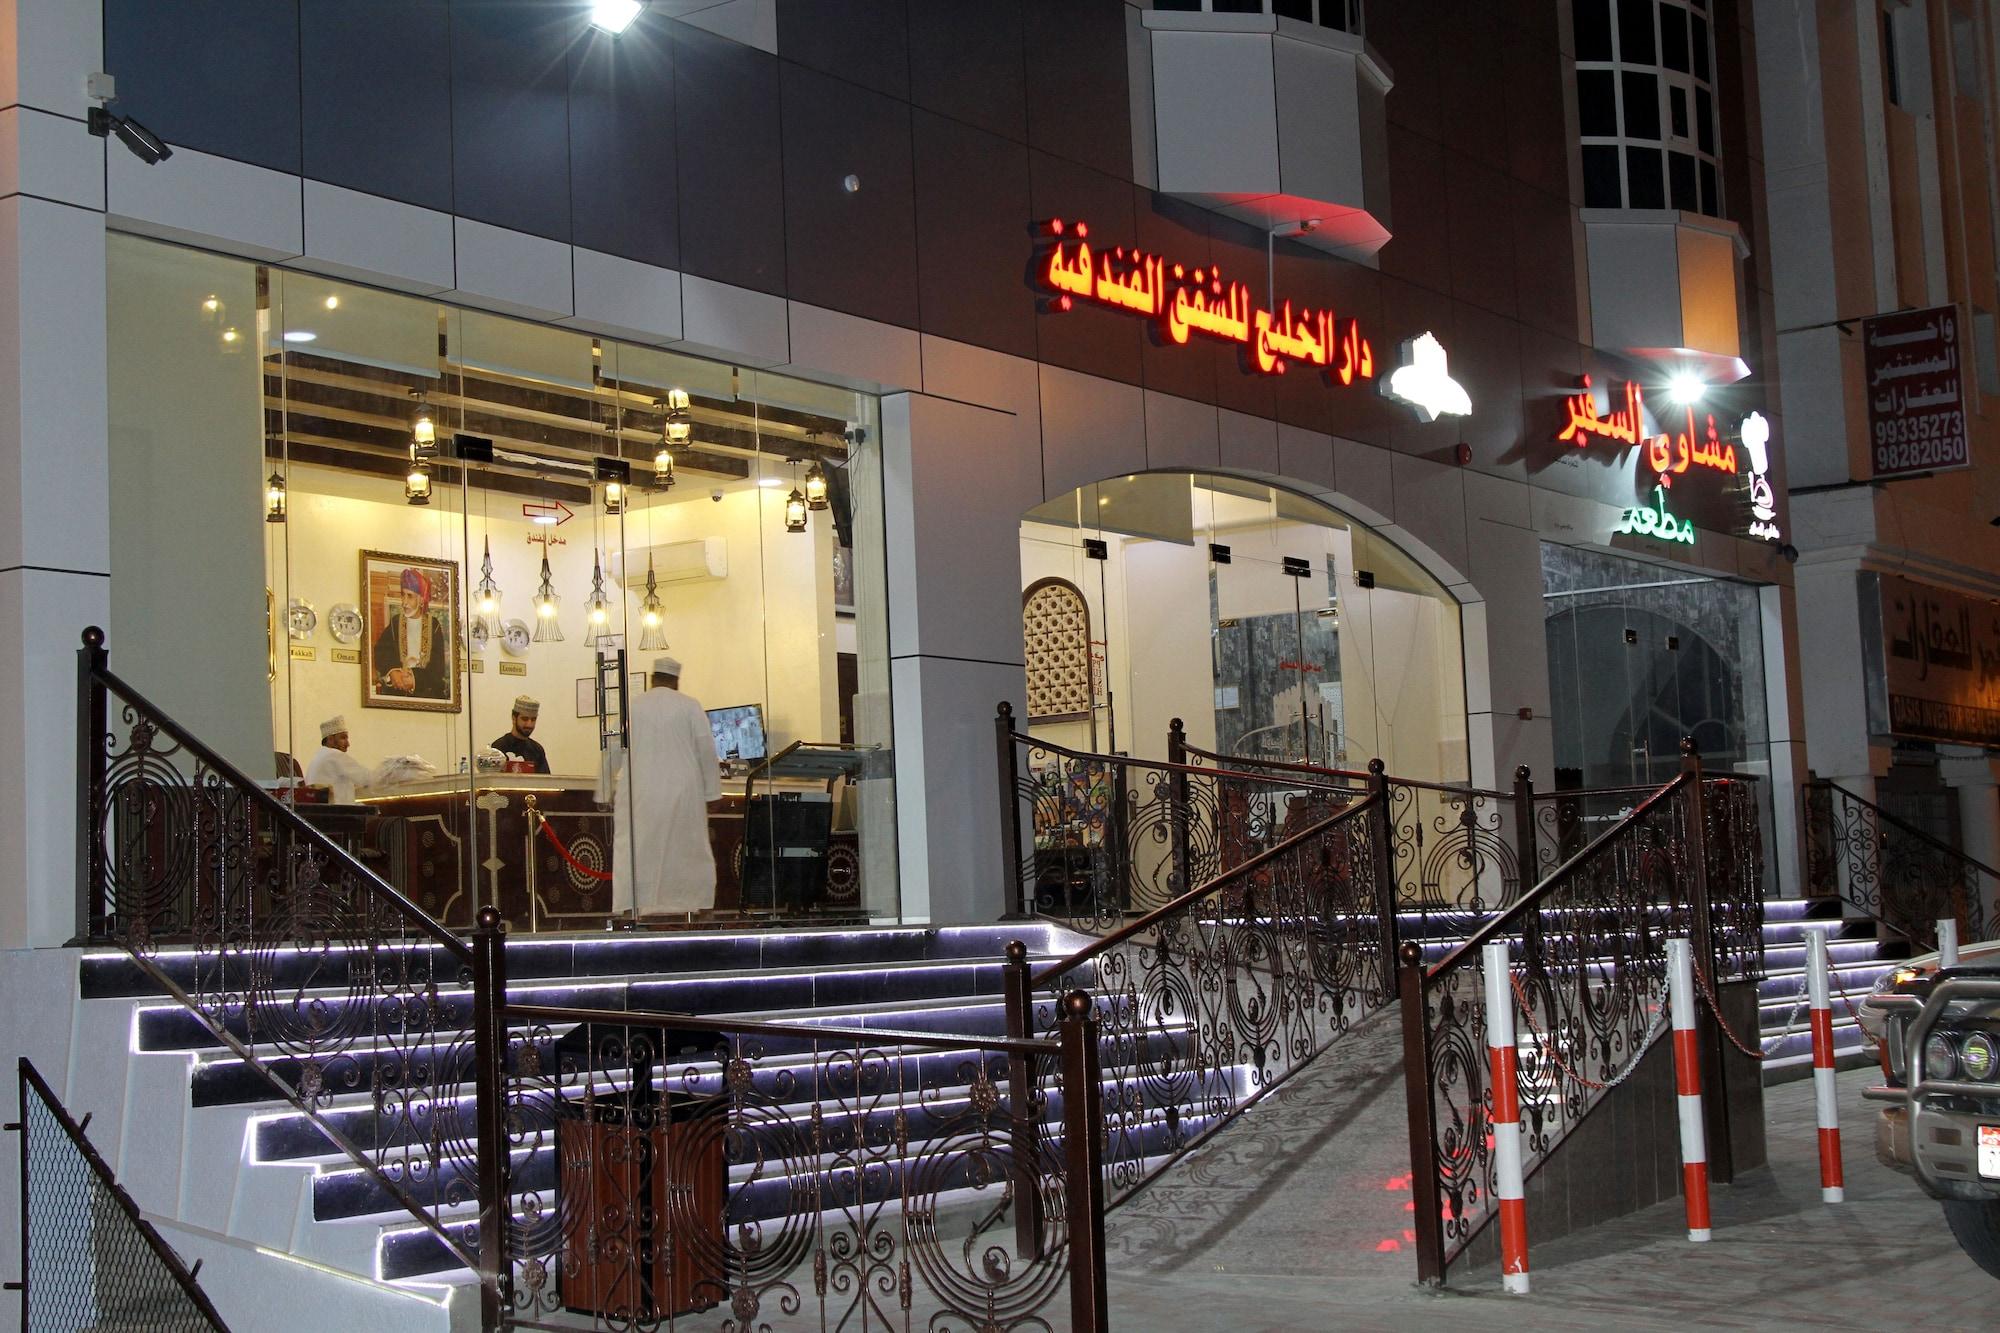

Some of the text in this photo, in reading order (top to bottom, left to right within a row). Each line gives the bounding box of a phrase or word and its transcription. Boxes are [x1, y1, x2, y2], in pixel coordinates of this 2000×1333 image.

[1048, 217, 1373, 386] دار الخليج للشقق الفندقية
[1874, 378, 1959, 416] للعقارات
[1558, 374, 1737, 489] مشاوي السفير
[1875, 410, 1963, 445] 99335273
[1877, 436, 1965, 471] 98282050
[1618, 484, 1697, 545] مطعم
[336, 652, 356, 661] Oman
